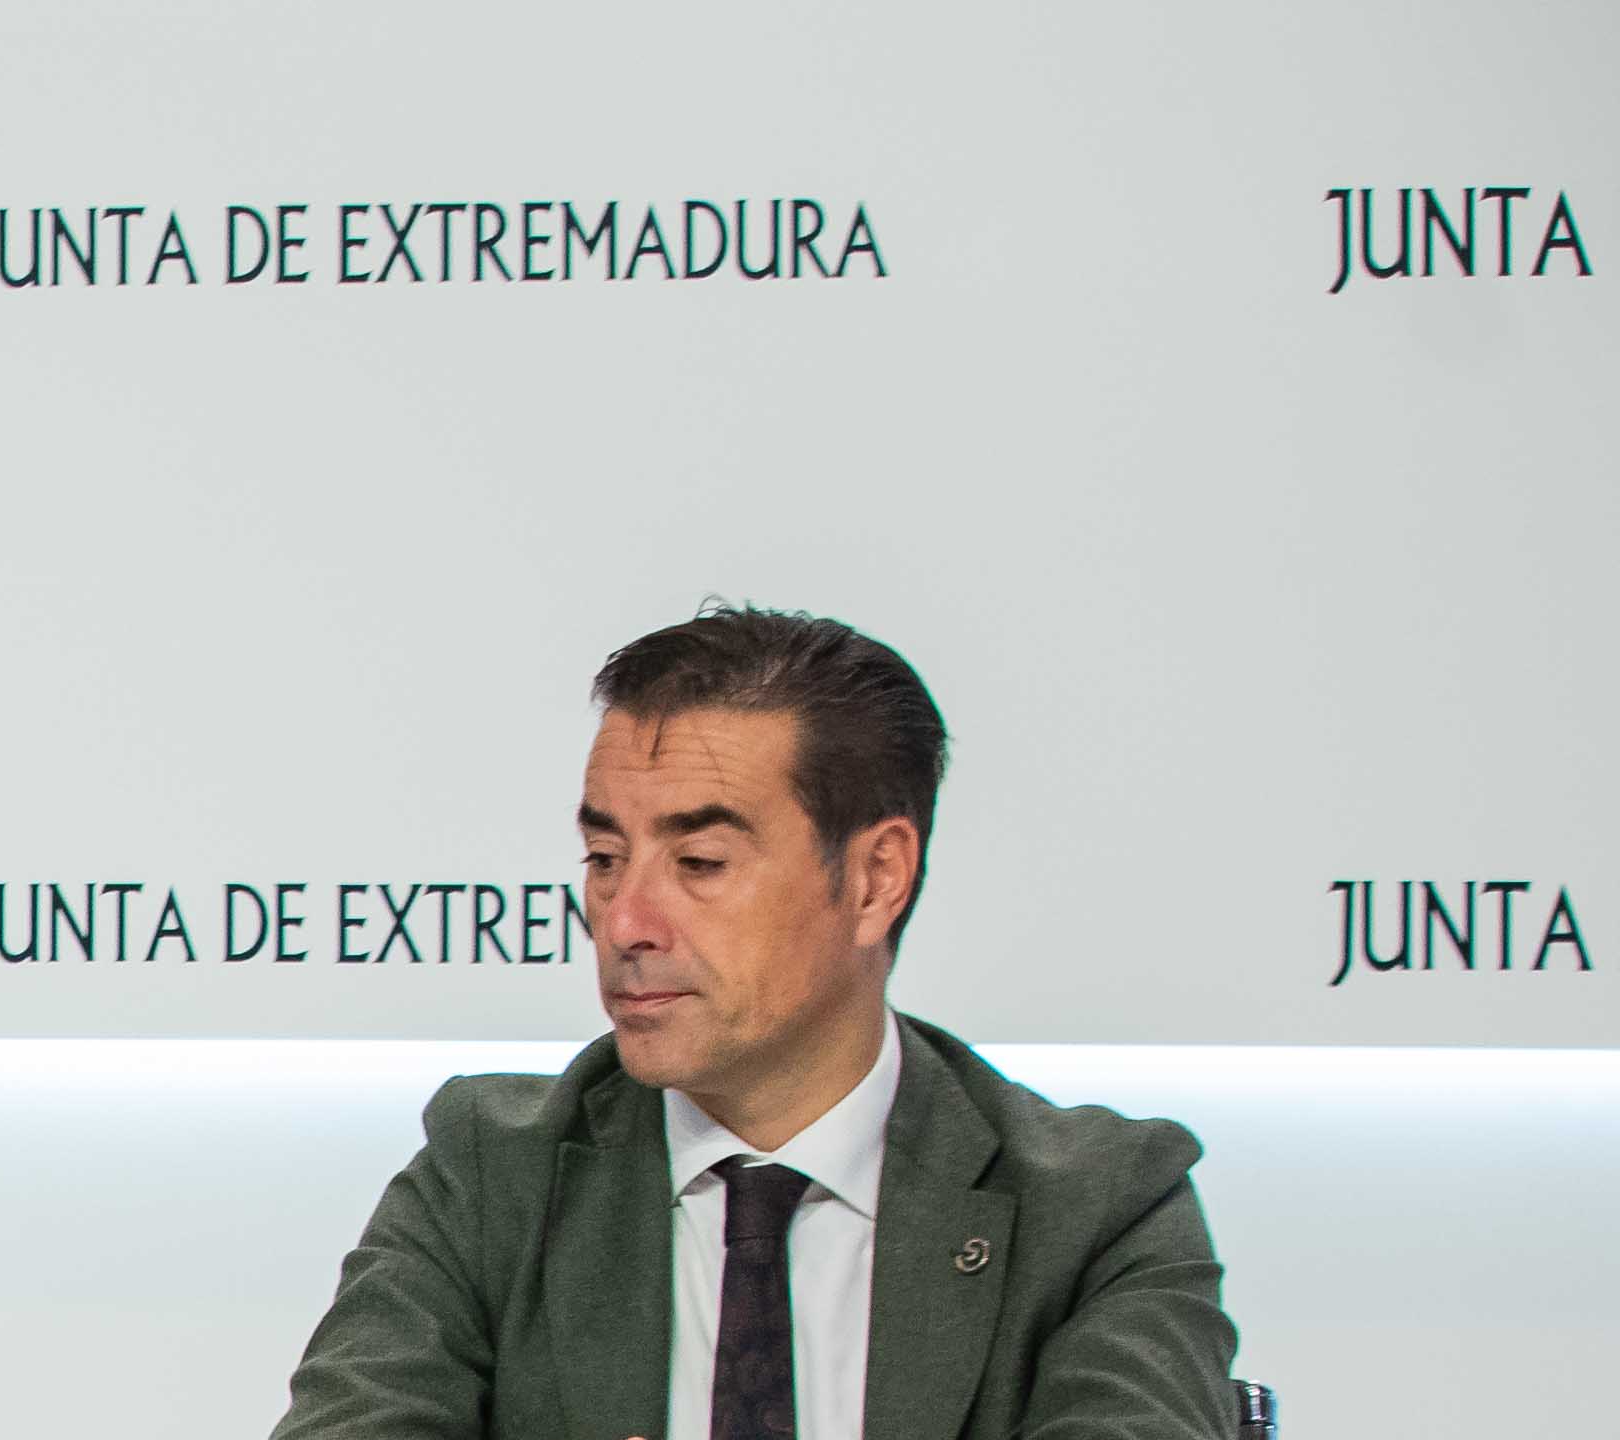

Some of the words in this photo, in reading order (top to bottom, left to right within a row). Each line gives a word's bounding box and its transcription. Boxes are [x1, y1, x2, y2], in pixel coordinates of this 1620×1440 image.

[225, 206, 311, 284] DE
[336, 201, 890, 283] EXTREMADURA
[1324, 187, 1593, 294] JUNTA
[223, 883, 310, 963] DE
[1327, 881, 1593, 986] JUNTA
